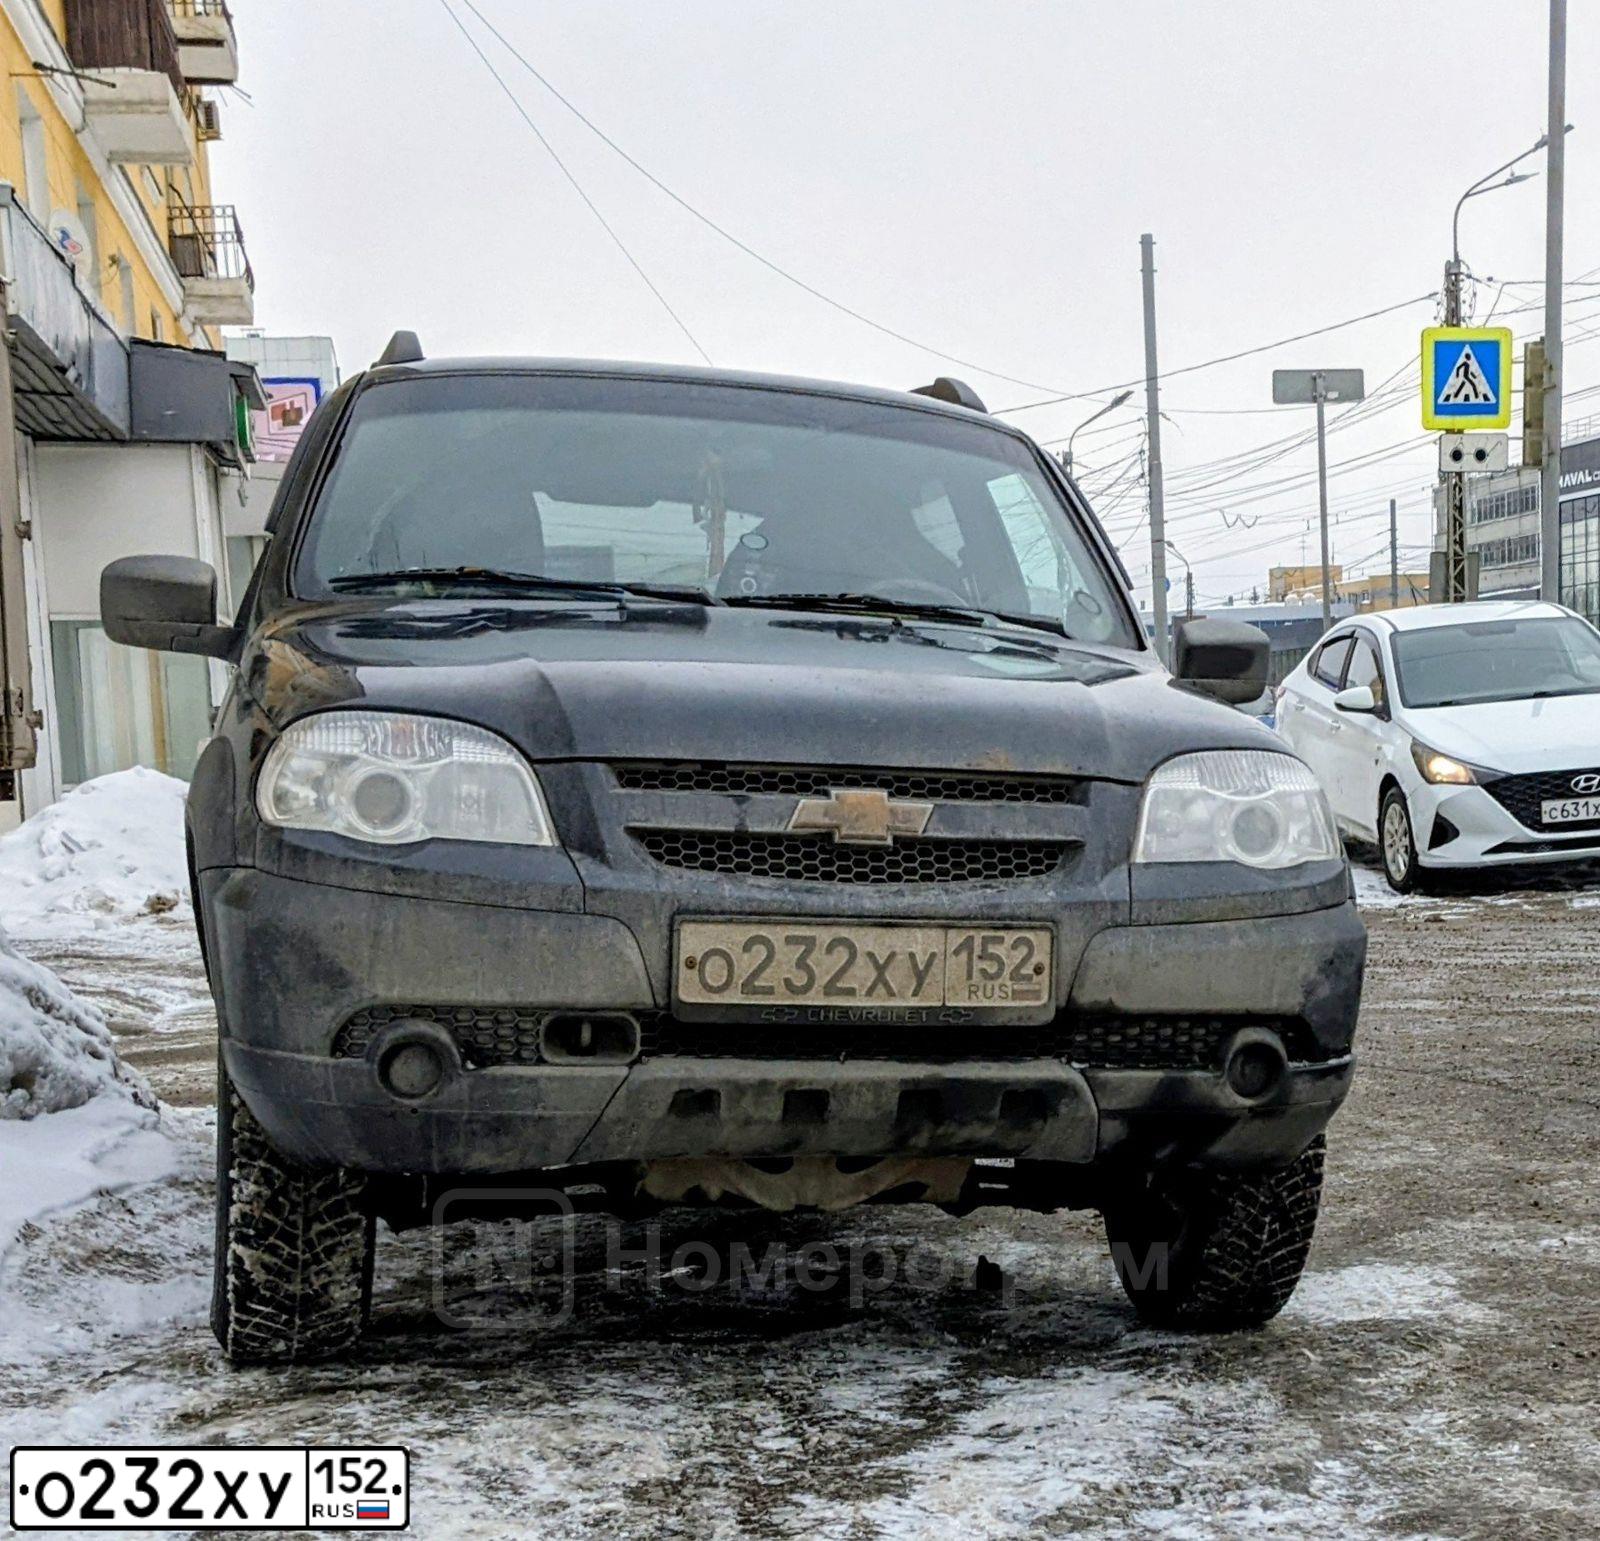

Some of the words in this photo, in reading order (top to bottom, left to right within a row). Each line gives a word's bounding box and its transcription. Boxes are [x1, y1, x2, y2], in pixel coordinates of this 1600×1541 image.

[699, 934, 938, 997] О232ХУ
[952, 934, 1035, 982] 152
[967, 984, 1010, 1000] RUS
[807, 1008, 929, 1023] CHEVROLET
